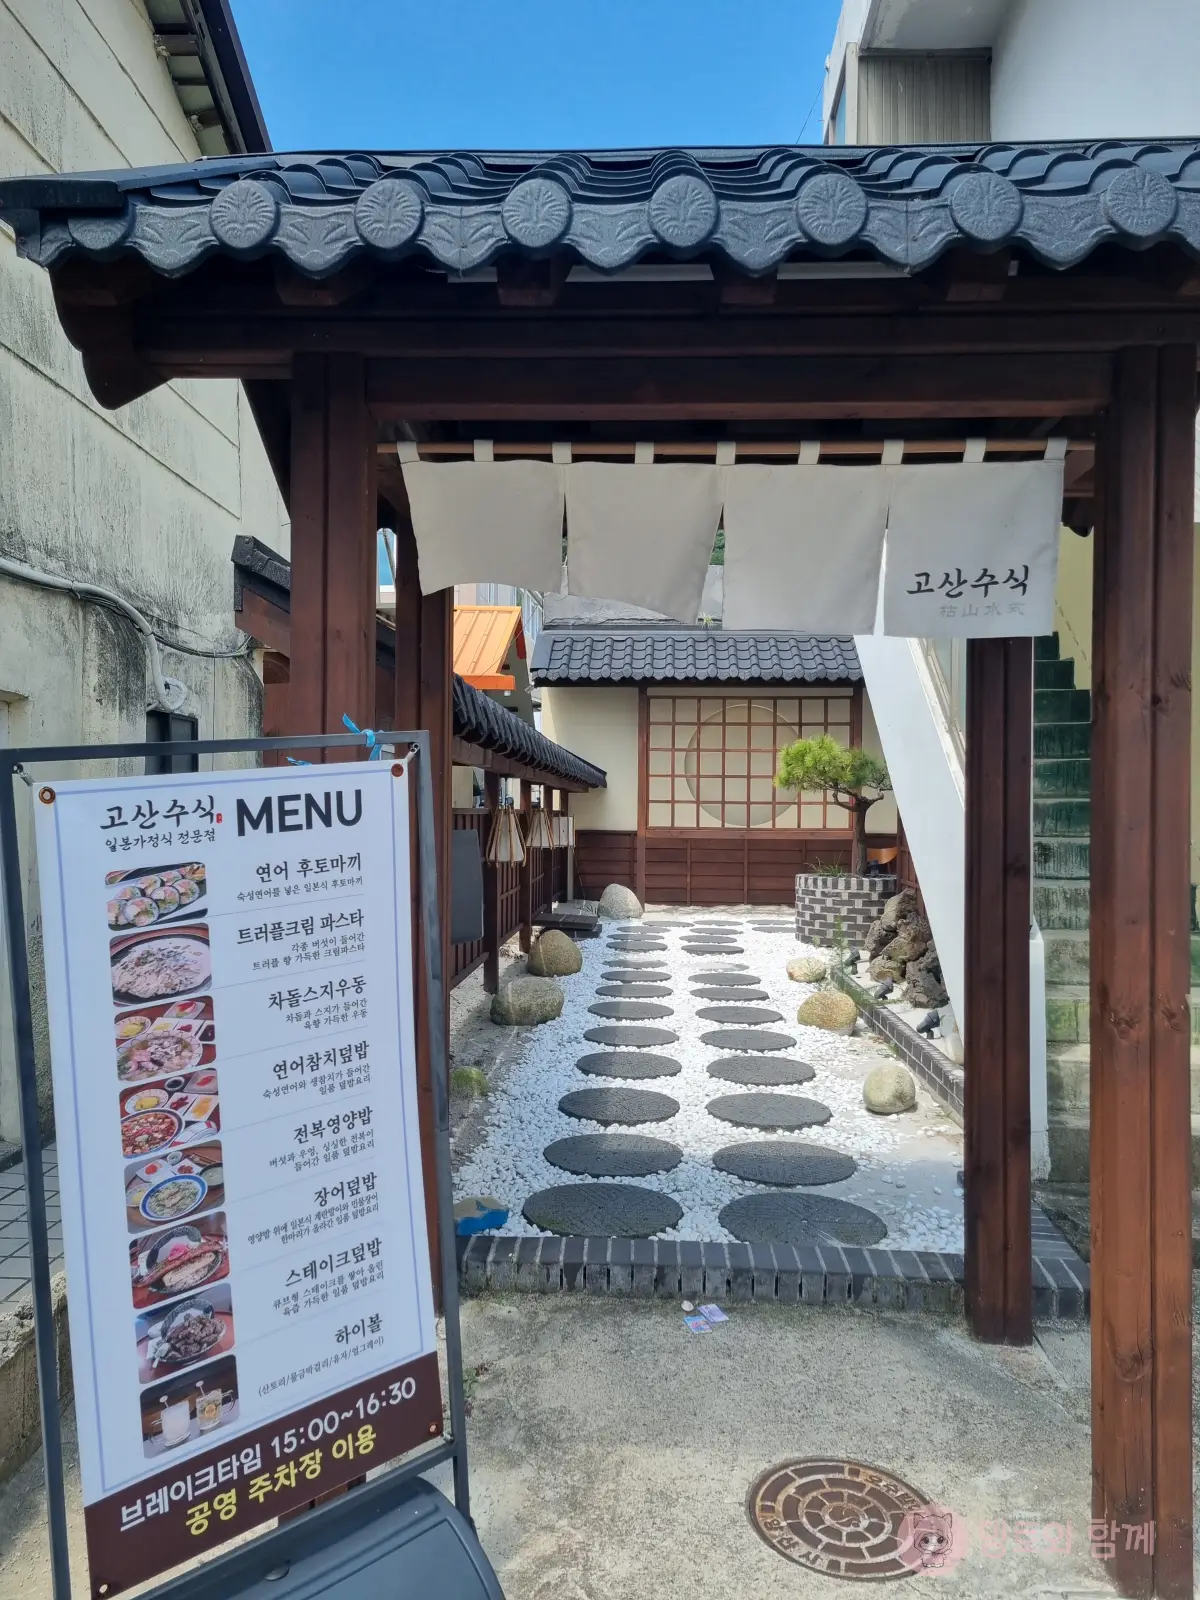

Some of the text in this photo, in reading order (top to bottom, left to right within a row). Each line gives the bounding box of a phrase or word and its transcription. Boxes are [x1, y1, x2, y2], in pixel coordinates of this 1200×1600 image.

[906, 565, 1029, 598] 고산수식
[100, 795, 216, 829] 고산수식
[236, 789, 363, 837] MENU
[105, 828, 216, 852] 일본가정식 전문점
[256, 852, 363, 883] 연어 후토마끼
[237, 876, 363, 901] 숙성연어를 넣은 일본식 후토마끼
[237, 908, 364, 944] 트러플크림 파스타
[291, 932, 365, 952] 각종 버섯이 들어간
[252, 943, 365, 970] 트러플 향 가득한 크림파스타
[268, 975, 367, 1011] 차돌스지우동
[286, 998, 368, 1023] 차돌과 스지가 들어간
[324, 1013, 349, 1025] 가득한
[352, 1009, 368, 1020] 우동
[273, 1040, 370, 1080] 연어참치덮밥
[263, 1080, 307, 1099] 숙성연어와
[346, 1063, 371, 1078] 들어간
[319, 1074, 371, 1096] 일품 덮밥요리
[294, 1106, 373, 1144] 전복영양밥
[269, 1152, 296, 1168] 버섯과
[323, 1137, 347, 1152] 싱싱한
[294, 1156, 320, 1172] 들어간
[343, 1139, 375, 1157] 덮밥요리
[314, 1171, 377, 1207] 장어덮밥
[290, 1214, 312, 1230] 일본식
[285, 1237, 382, 1287] 스테이크덮밥
[303, 1274, 345, 1298] 스테이크를
[304, 1291, 329, 1308] 가득한
[332, 1284, 348, 1298] 일품
[352, 1271, 384, 1290] 덮밥요리
[335, 1313, 383, 1344] 하이볼
[120, 1376, 416, 1532] 브레이크타임 15:00~16:30
[185, 1424, 377, 1535] 공영 주차장 이용
